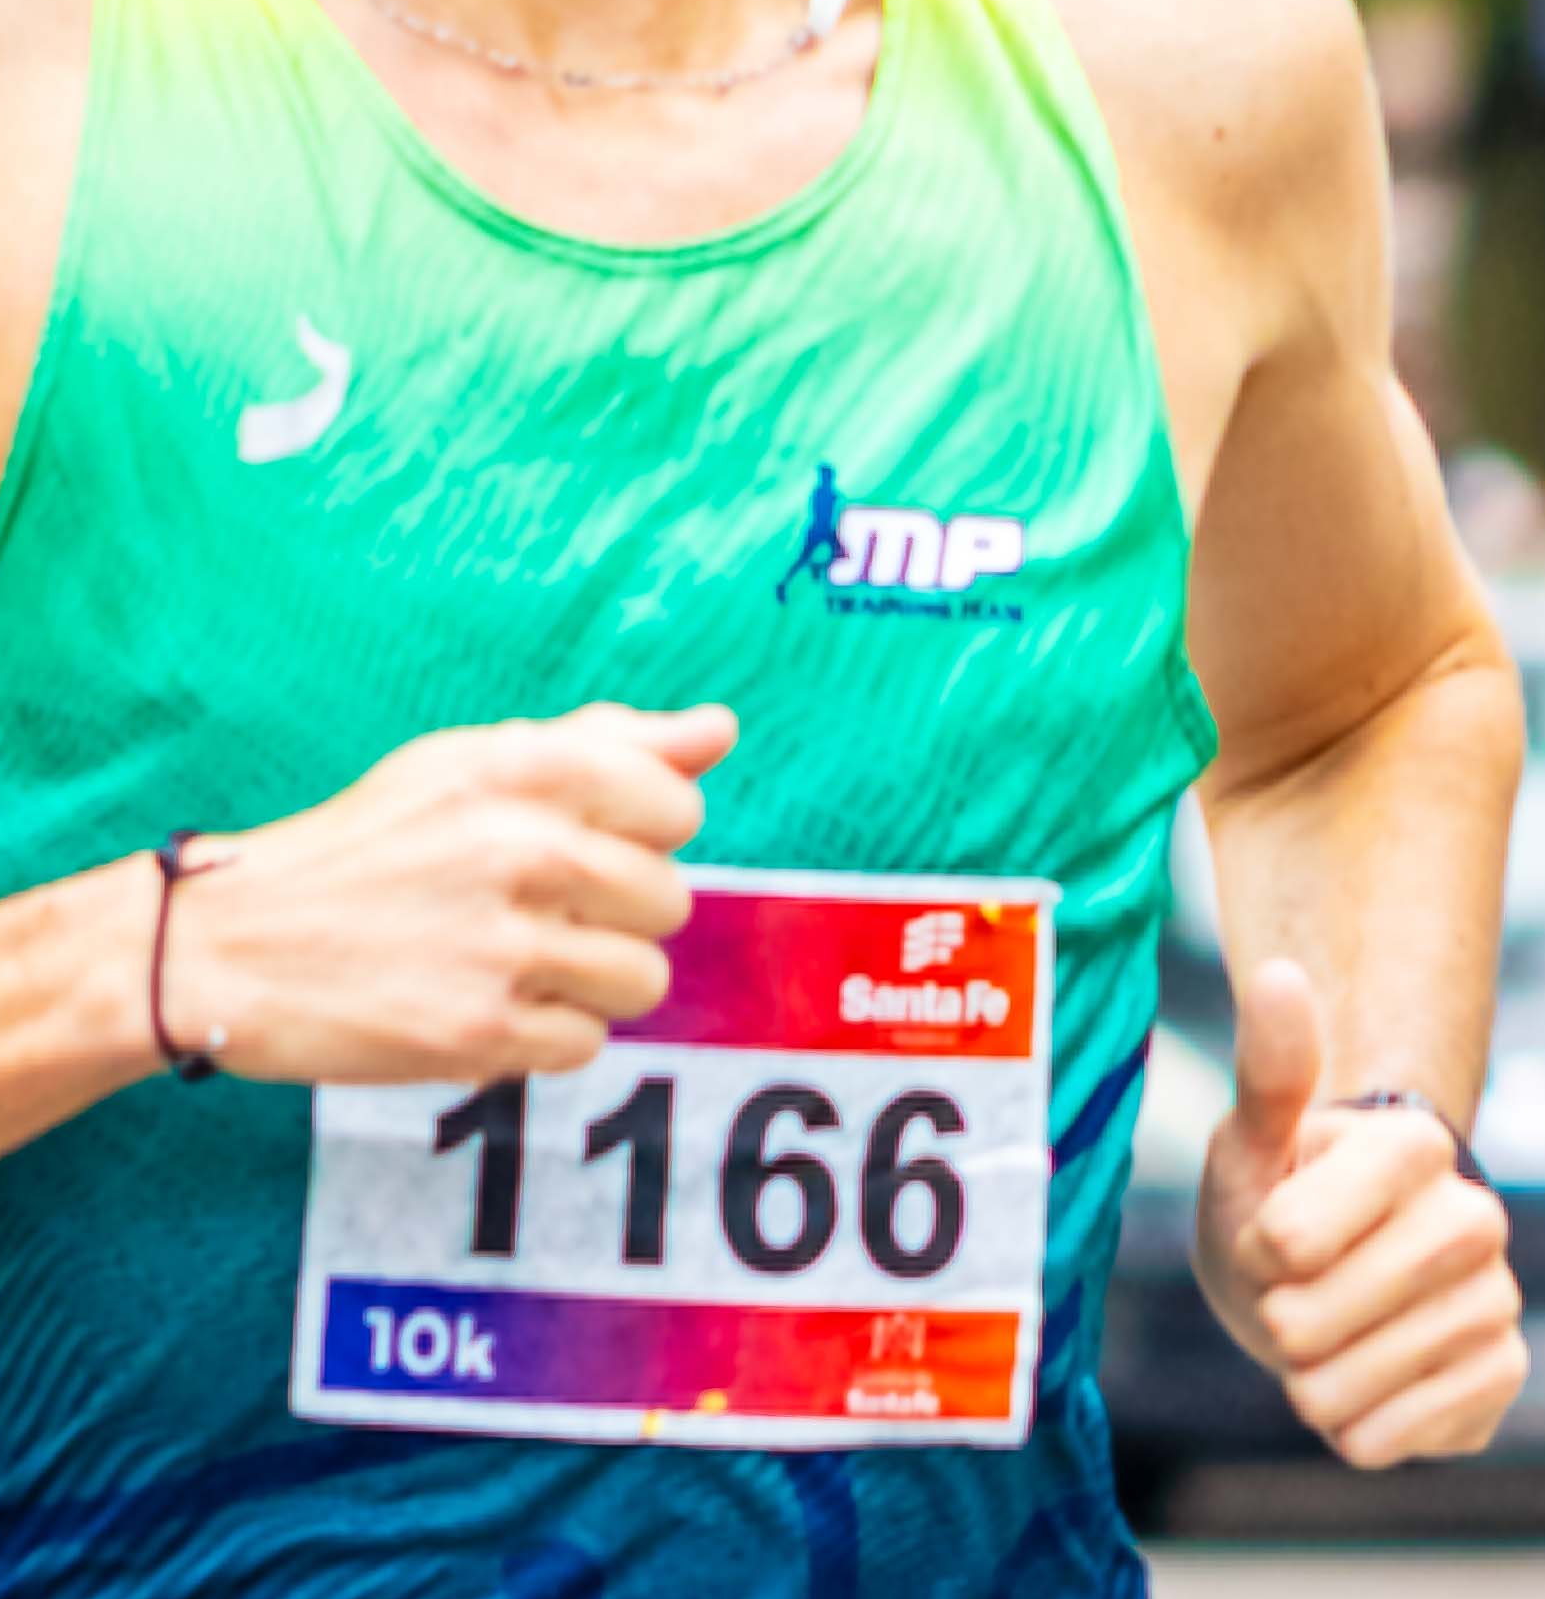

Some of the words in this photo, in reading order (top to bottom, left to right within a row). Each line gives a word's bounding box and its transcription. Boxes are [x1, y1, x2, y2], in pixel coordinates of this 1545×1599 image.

[827, 505, 1023, 591] MP
[839, 973, 962, 1023] Santa
[964, 979, 1011, 1026] Fe
[433, 1075, 968, 1278] 1166
[363, 1306, 497, 1382] 10k
